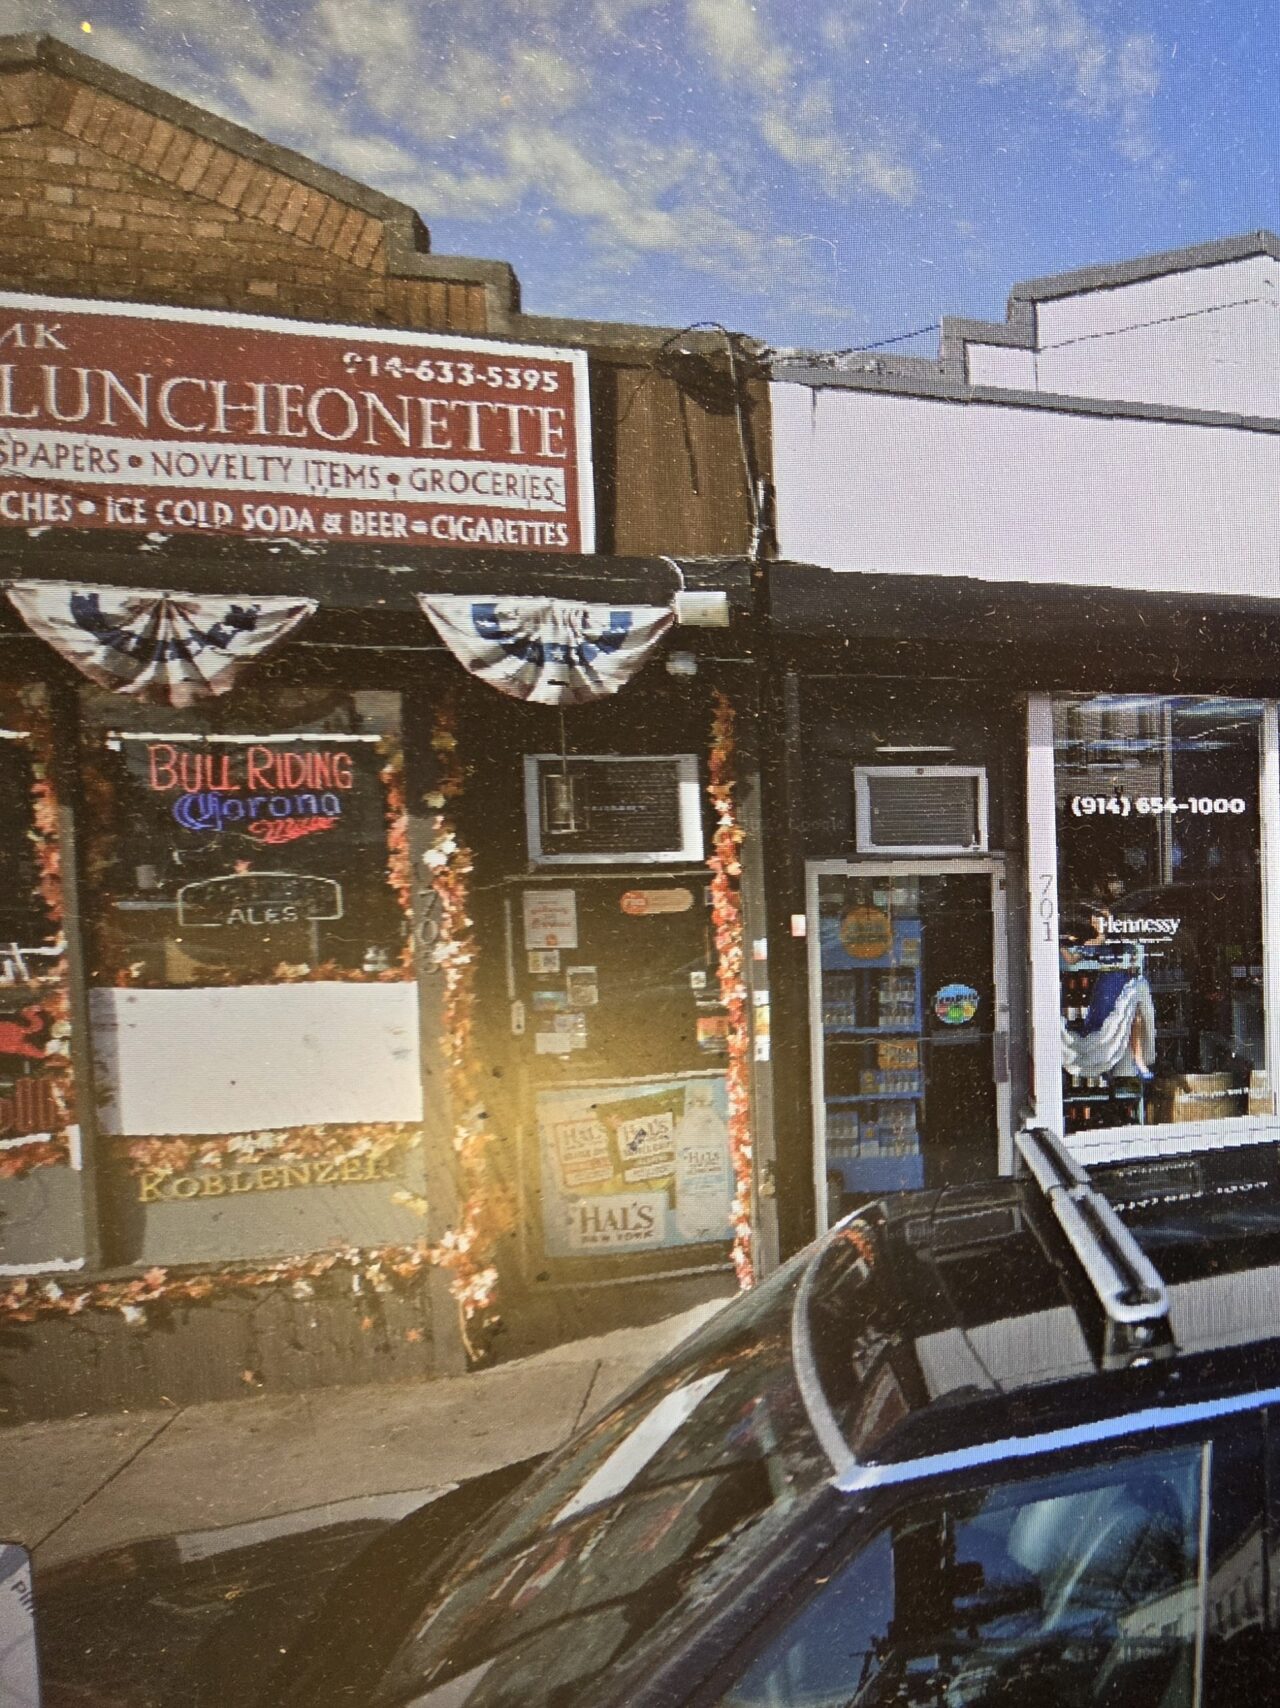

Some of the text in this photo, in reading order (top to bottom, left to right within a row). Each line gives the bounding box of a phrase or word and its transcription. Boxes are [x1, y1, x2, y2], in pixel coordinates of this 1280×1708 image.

[343, 352, 559, 393] 914-633-5395
[0, 363, 568, 459] LUNCHEONETTE
[151, 449, 293, 483] NOVELTY
[304, 459, 381, 490] ITEMS
[408, 467, 561, 502] GROCERIES
[104, 496, 149, 525] ICE
[155, 499, 235, 530] COLD
[242, 503, 317, 534] SODA
[321, 511, 344, 535] &
[350, 509, 409, 539] BEER
[430, 514, 569, 547] CIGARETTES
[247, 744, 354, 791] RIDING
[172, 791, 342, 833] Corona
[1070, 796, 1246, 817] (914) 654-1000
[226, 905, 299, 926] ALES
[1038, 873, 1055, 943] 701
[1098, 913, 1182, 936] Hennessy
[579, 1202, 655, 1234] HAL'S
